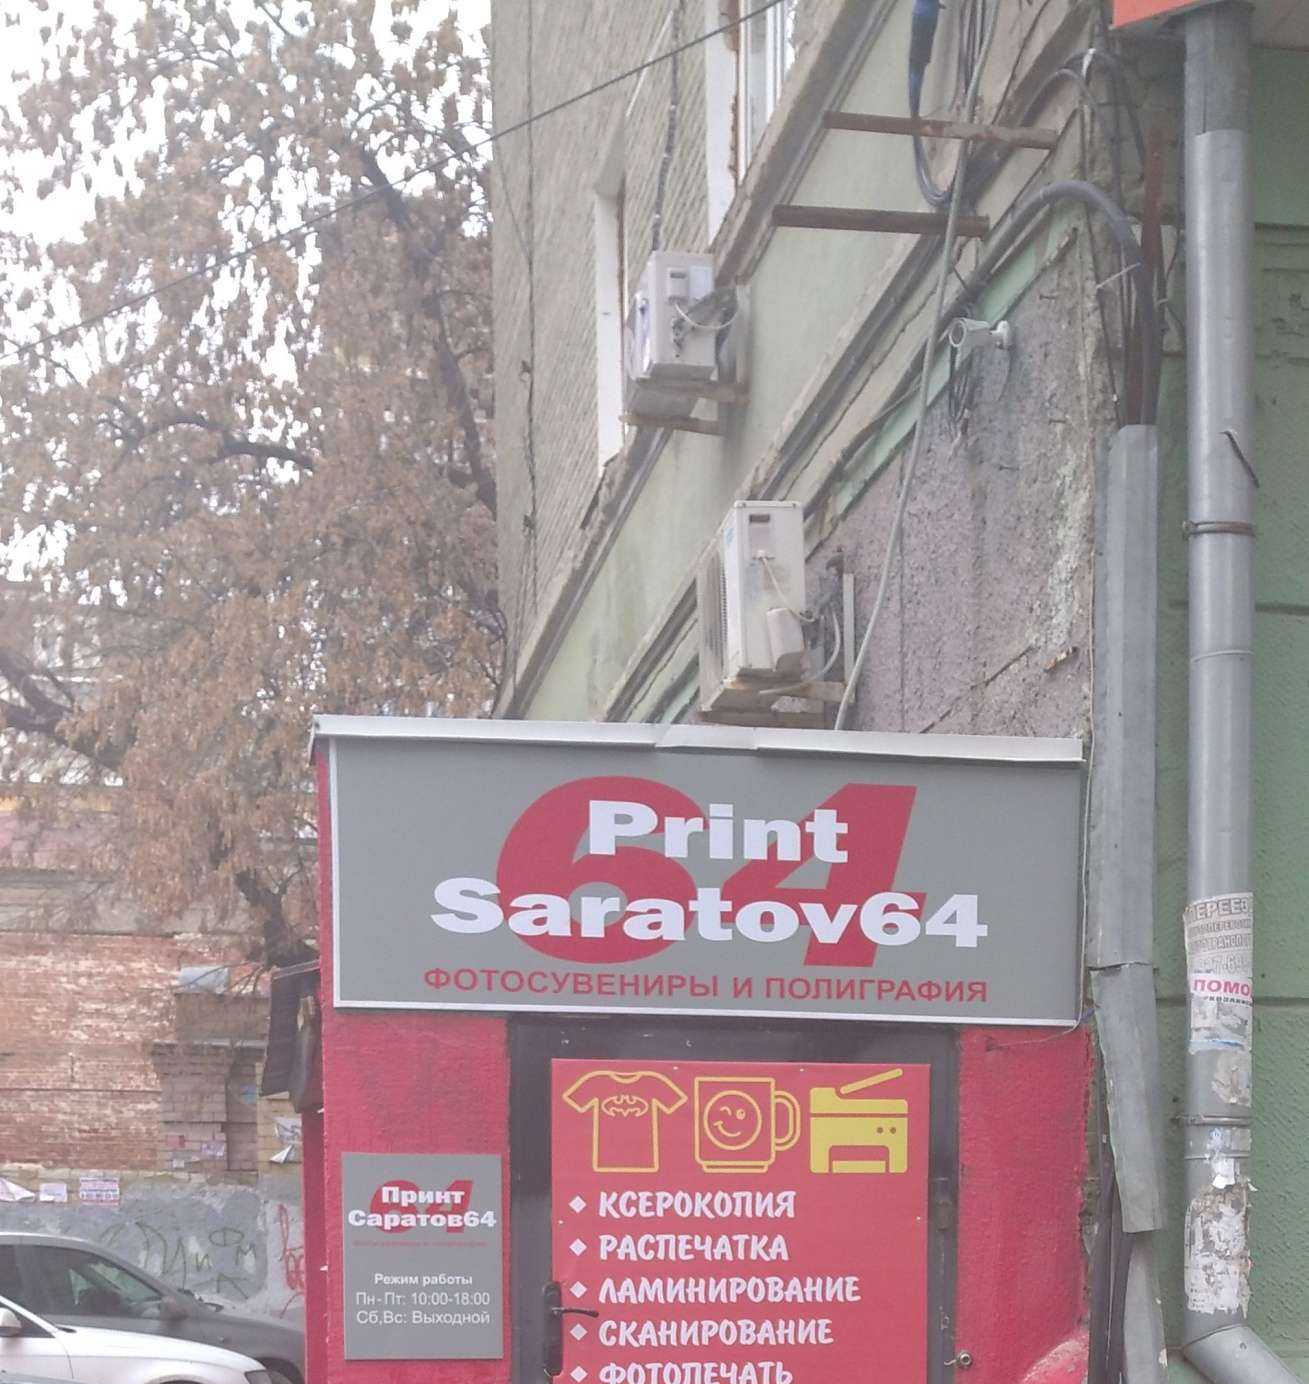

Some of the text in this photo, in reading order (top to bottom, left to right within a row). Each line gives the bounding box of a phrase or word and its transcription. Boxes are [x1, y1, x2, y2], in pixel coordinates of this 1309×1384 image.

[588, 800, 848, 864] Print
[430, 877, 988, 947] Saratov64
[424, 967, 988, 1003] ФОТОСУВЕНИРЫ И ПОЛИГРАФИЯ
[381, 1186, 465, 1206] Принт
[598, 1190, 797, 1219] КСЕРОКОПИЯ
[348, 1209, 497, 1230] Саратов64
[599, 1234, 790, 1261] РАСПЕЧАТКА
[374, 1273, 473, 1287] Режим работы
[598, 1276, 862, 1304] ЛАМИНИРОВАНИЕ
[411, 1291, 491, 1306] 10:00-18:00
[412, 1310, 491, 1326] Выходной
[598, 1319, 834, 1347] СКАНИРОВАНИЕ
